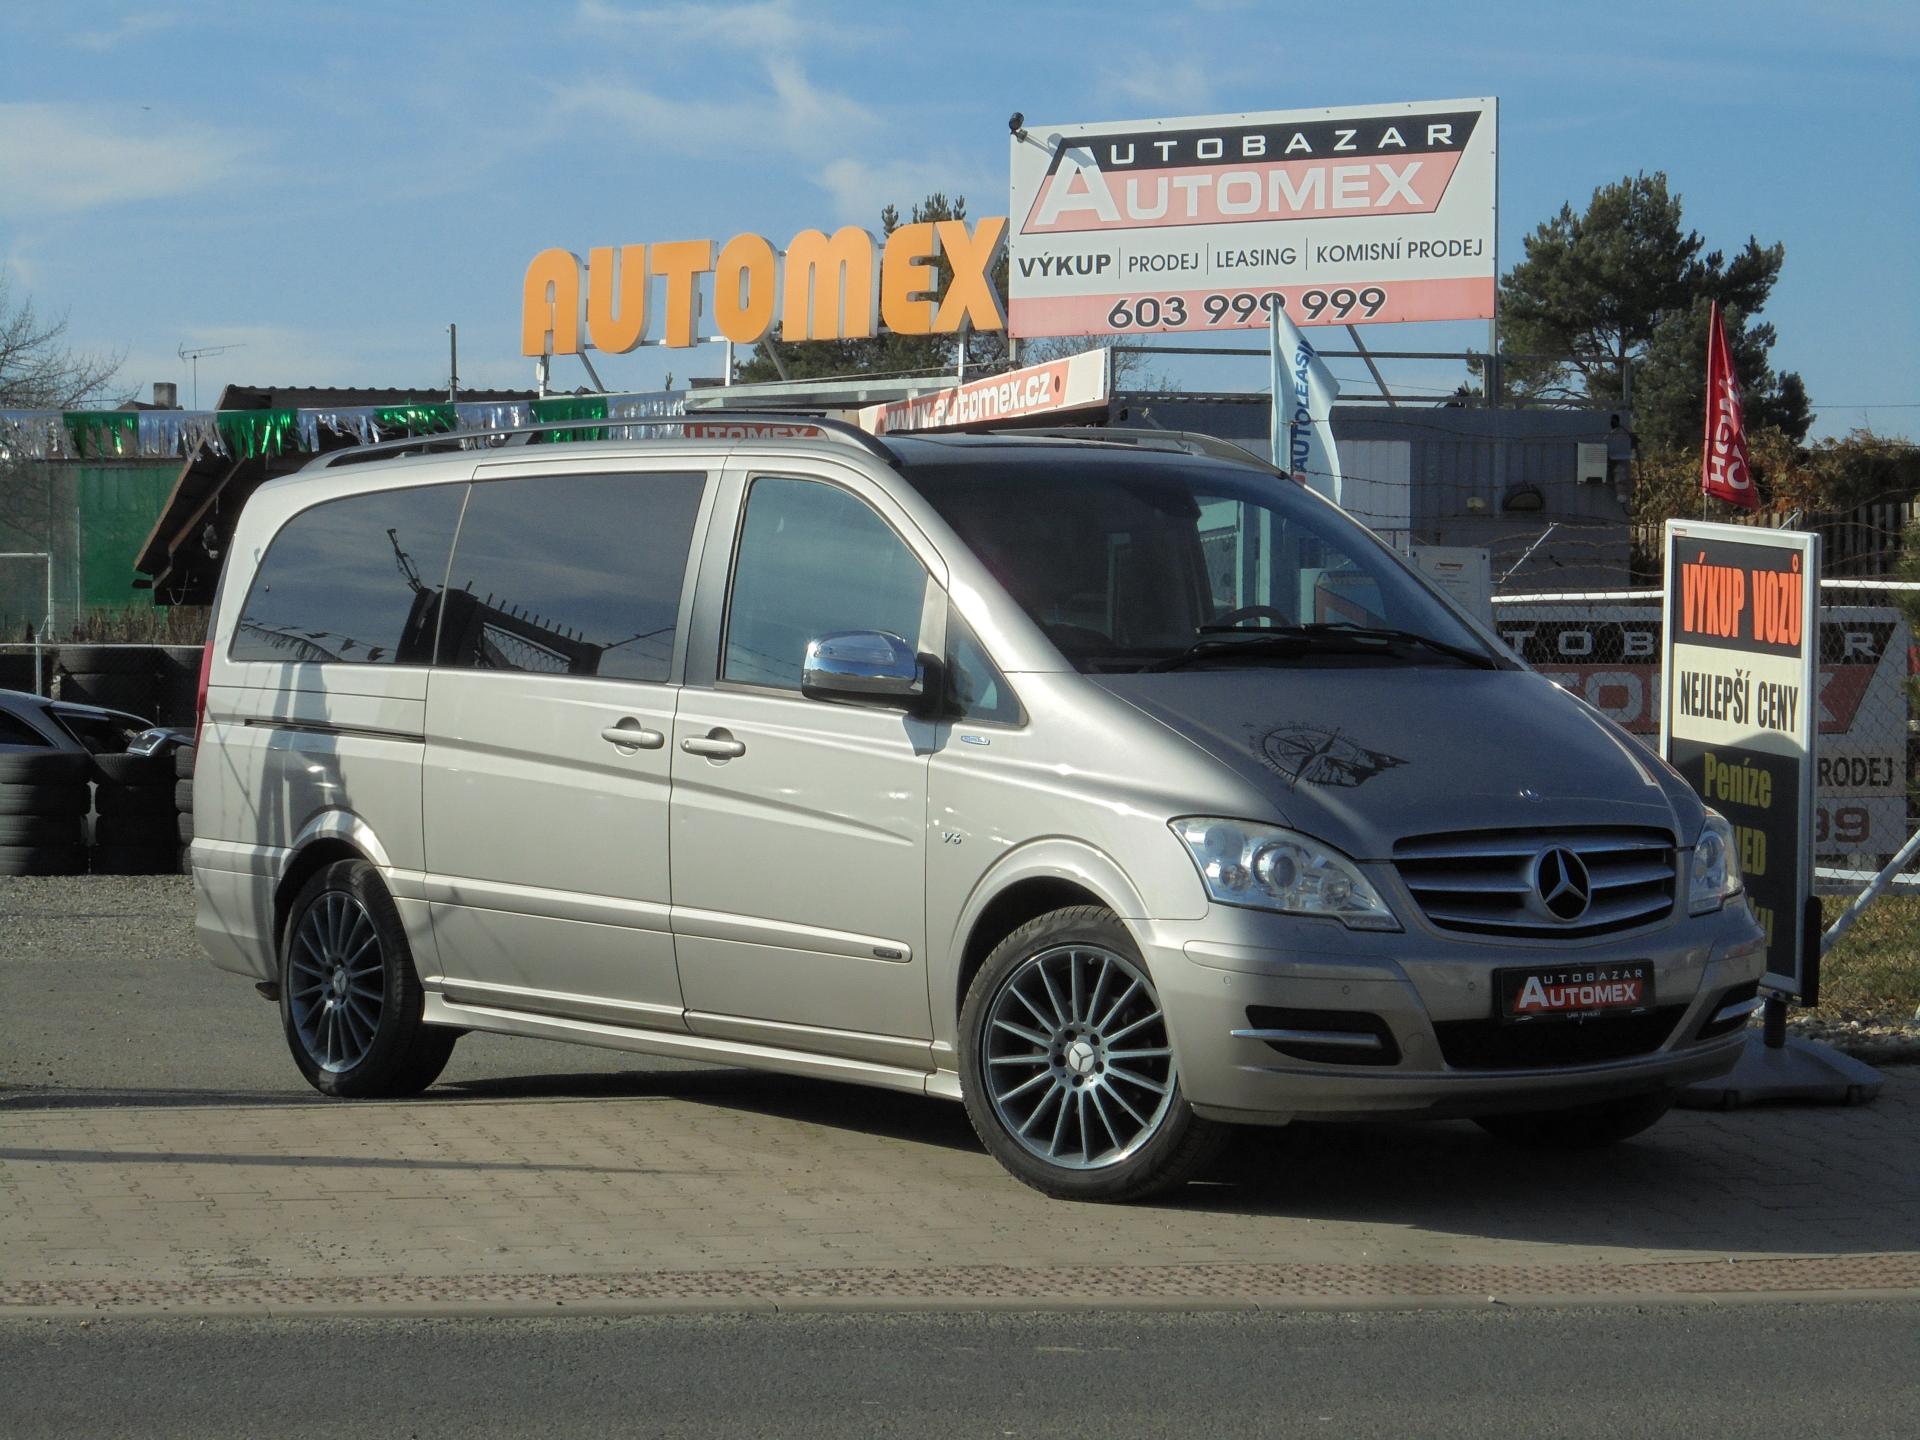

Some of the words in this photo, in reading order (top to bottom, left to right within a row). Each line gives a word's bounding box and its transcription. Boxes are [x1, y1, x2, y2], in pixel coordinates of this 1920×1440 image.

[1034, 146, 1425, 226] AUTOMEX
[1018, 250, 1112, 278] VÝKUP
[1128, 252, 1199, 274] PRODEJ
[1216, 247, 1297, 269] LEASING
[1316, 236, 1403, 264] KOMISNÍ
[1408, 238, 1484, 260] PRODEJ
[522, 217, 1010, 356] AUTOMEX
[1107, 296, 1188, 329] 603
[1301, 286, 1387, 322] 999
[1682, 551, 1744, 638] VÝKUP
[1752, 554, 1801, 646] VOZŮ
[1680, 668, 1750, 725] NEJLEPŠÍ
[1757, 680, 1798, 733] CENY
[1704, 752, 1772, 809] Peníze
[1817, 757, 1893, 787] RODEJ
[1518, 976, 1637, 1009] AUTOMEX
